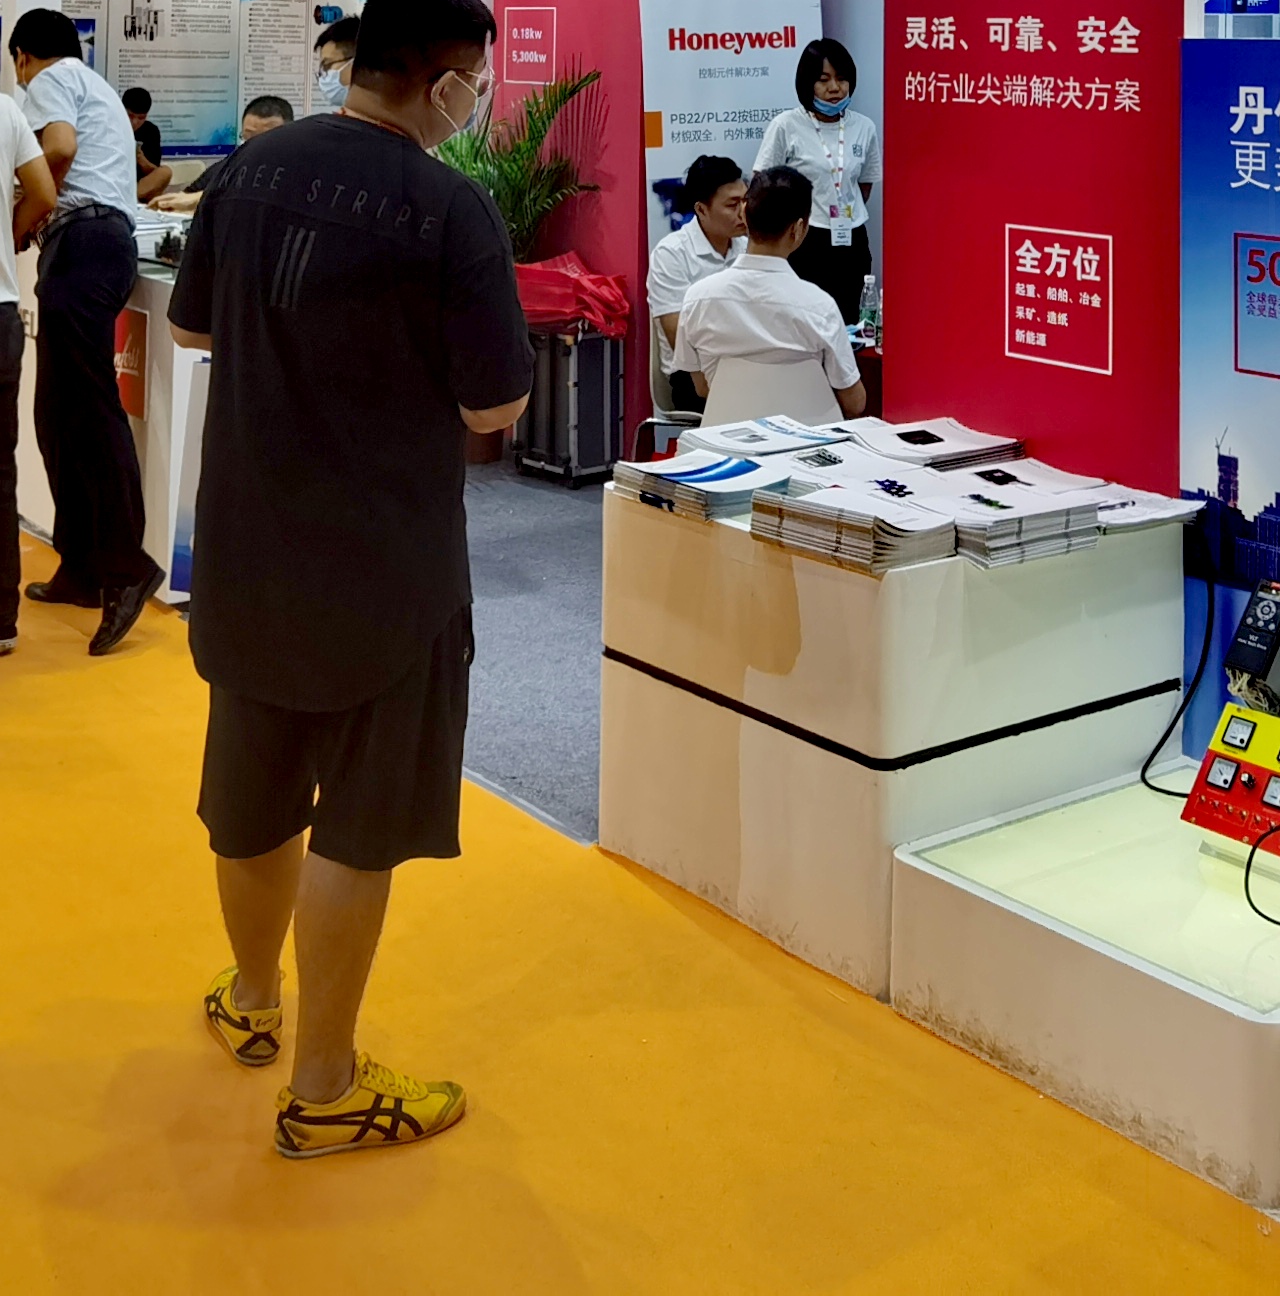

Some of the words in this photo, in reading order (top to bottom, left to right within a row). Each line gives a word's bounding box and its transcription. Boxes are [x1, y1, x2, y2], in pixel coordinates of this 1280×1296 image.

[512, 27, 543, 41] 0.18kw
[668, 25, 797, 55] Honeywell
[904, 15, 1141, 54] 灵活、可靠、安全
[512, 50, 547, 65] 5,300kw
[698, 66, 770, 80] 控制元件解决方案
[904, 71, 1141, 113] 的行业尖端解决方案
[1014, 239, 1101, 282] 全方位
[1014, 282, 1102, 308] 起重、船舶、冶金
[1014, 305, 1069, 328] 采矿、造纸
[1014, 328, 1047, 347] 新能源
